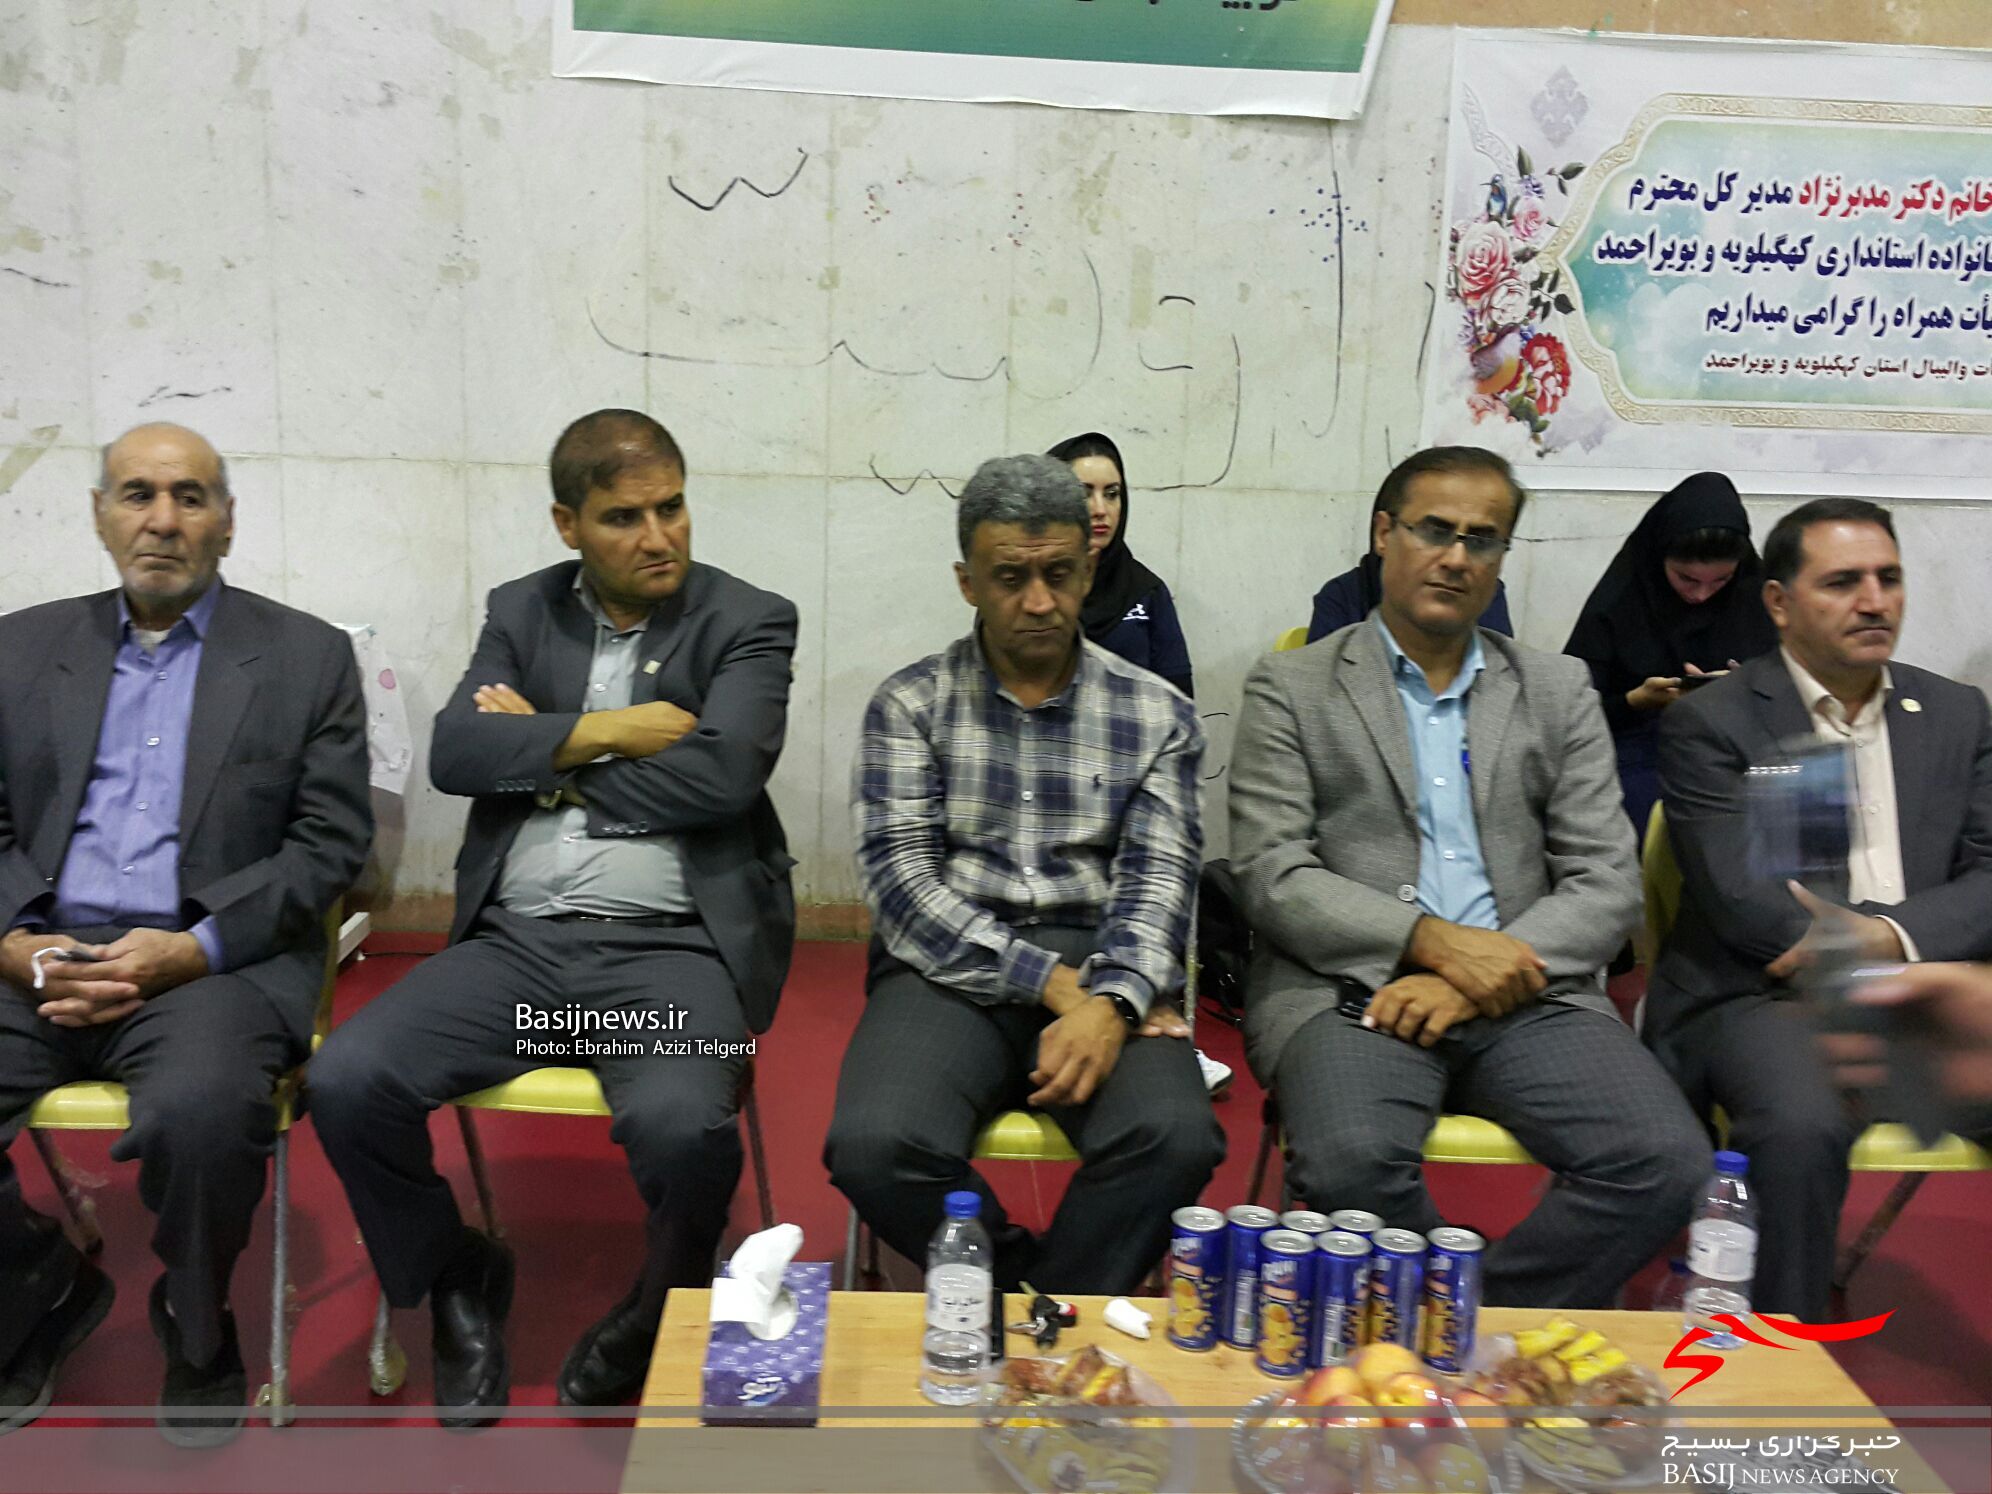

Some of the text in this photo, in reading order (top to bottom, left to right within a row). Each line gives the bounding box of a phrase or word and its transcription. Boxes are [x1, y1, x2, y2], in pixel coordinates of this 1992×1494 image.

[1629, 174, 1698, 211] محترم
[1704, 171, 1739, 211] کل
[1740, 181, 1793, 213] مدیر
[1893, 179, 1945, 220] دکتر
[1598, 229, 1992, 281] انواده استانداری کهگیلویه و بویراحمد
[1706, 292, 1788, 333] میداریم
[1793, 294, 1866, 335] گرامی
[1869, 296, 1887, 337] را
[1893, 298, 1954, 338] همراه
[1706, 353, 1775, 374] بویراحمد
[1778, 359, 1789, 375] و
[1795, 355, 1860, 377] کهگیلویه
[1863, 358, 1908, 378] استان
[1912, 359, 1968, 380] والیبال
